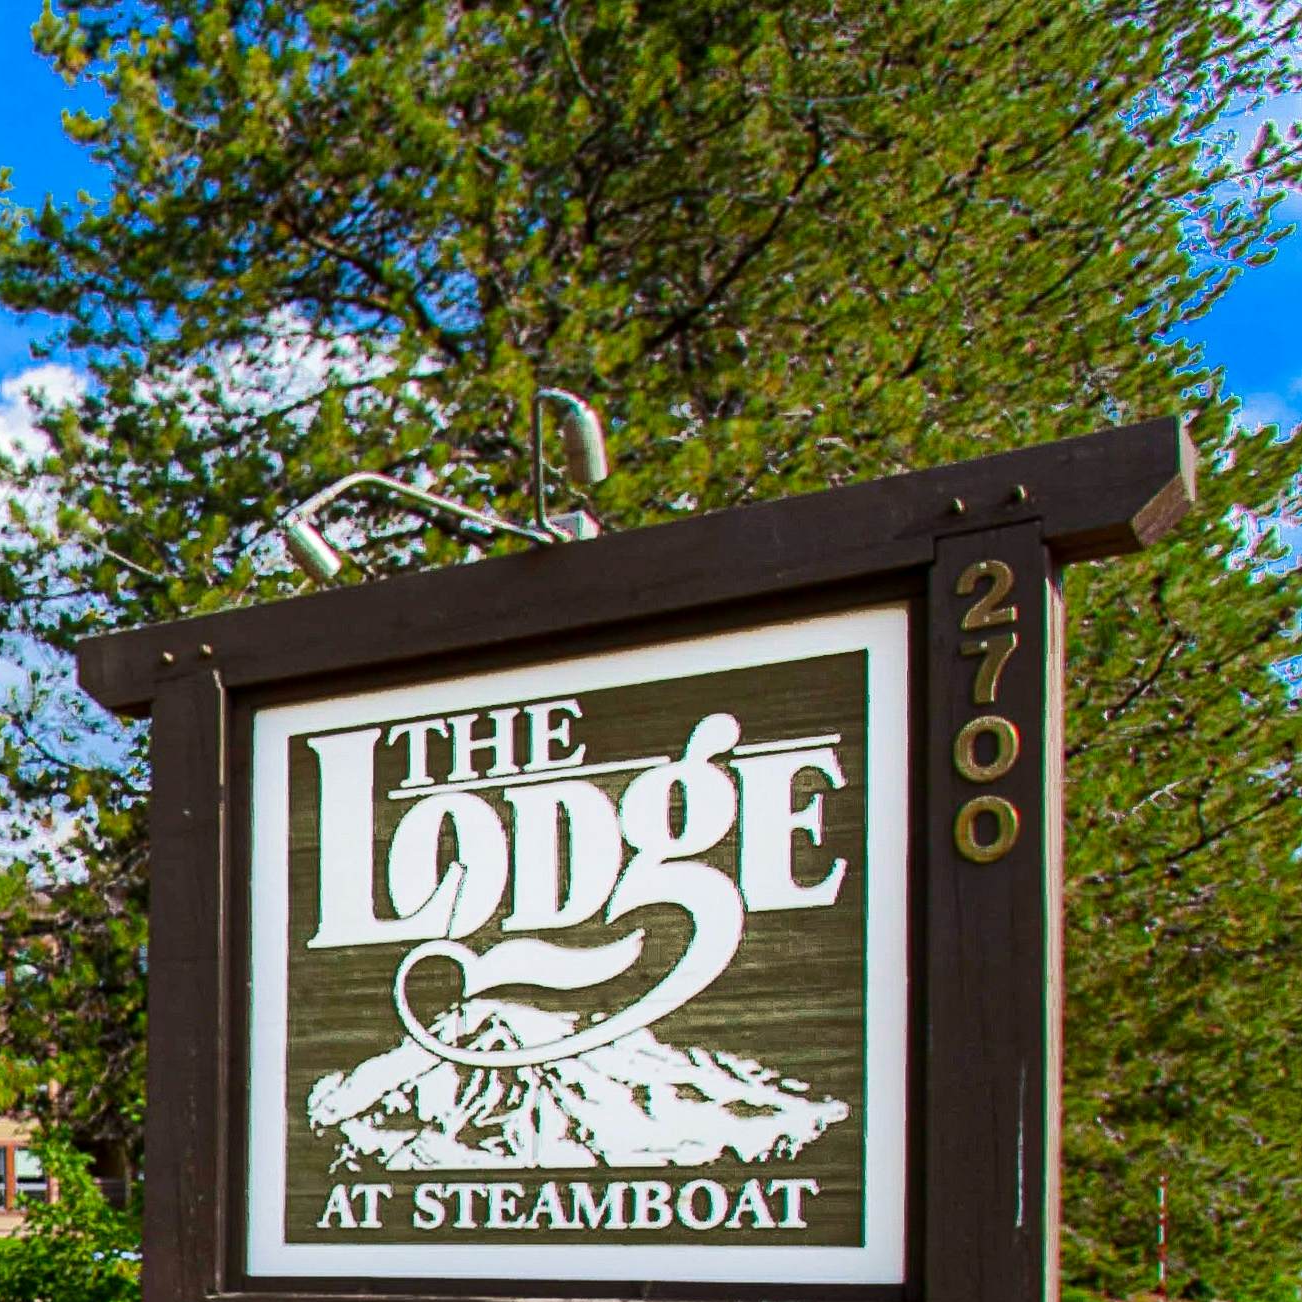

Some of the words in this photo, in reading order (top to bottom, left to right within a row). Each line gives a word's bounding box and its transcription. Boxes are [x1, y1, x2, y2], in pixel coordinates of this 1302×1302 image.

[388, 698, 586, 787] THE
[953, 560, 1020, 864] 2700
[318, 1184, 393, 1229] AT
[413, 1178, 819, 1231] STEAMBOAT
